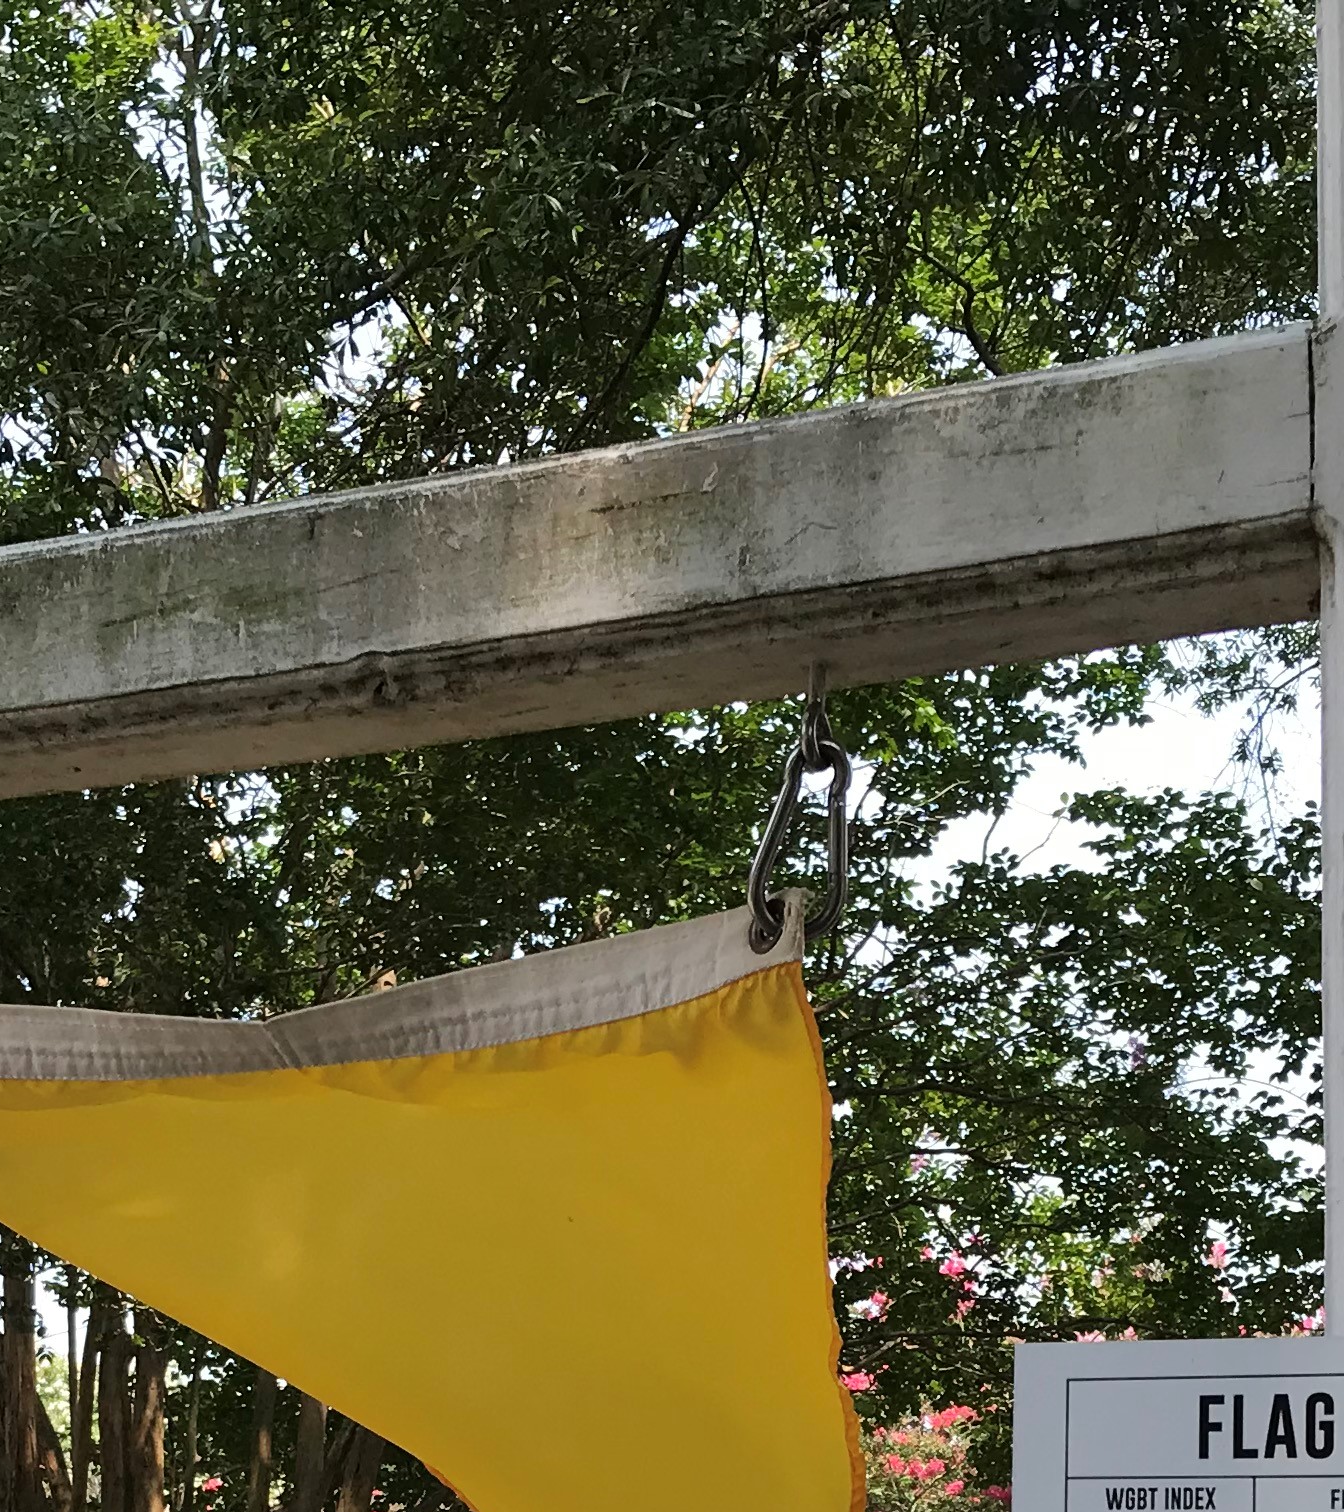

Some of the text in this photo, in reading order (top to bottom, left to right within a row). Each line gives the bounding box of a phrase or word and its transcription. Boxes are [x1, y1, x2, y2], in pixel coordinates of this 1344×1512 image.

[1198, 1392, 1335, 1460] FLAG
[1105, 1487, 1216, 1510] WGBT INDEX
